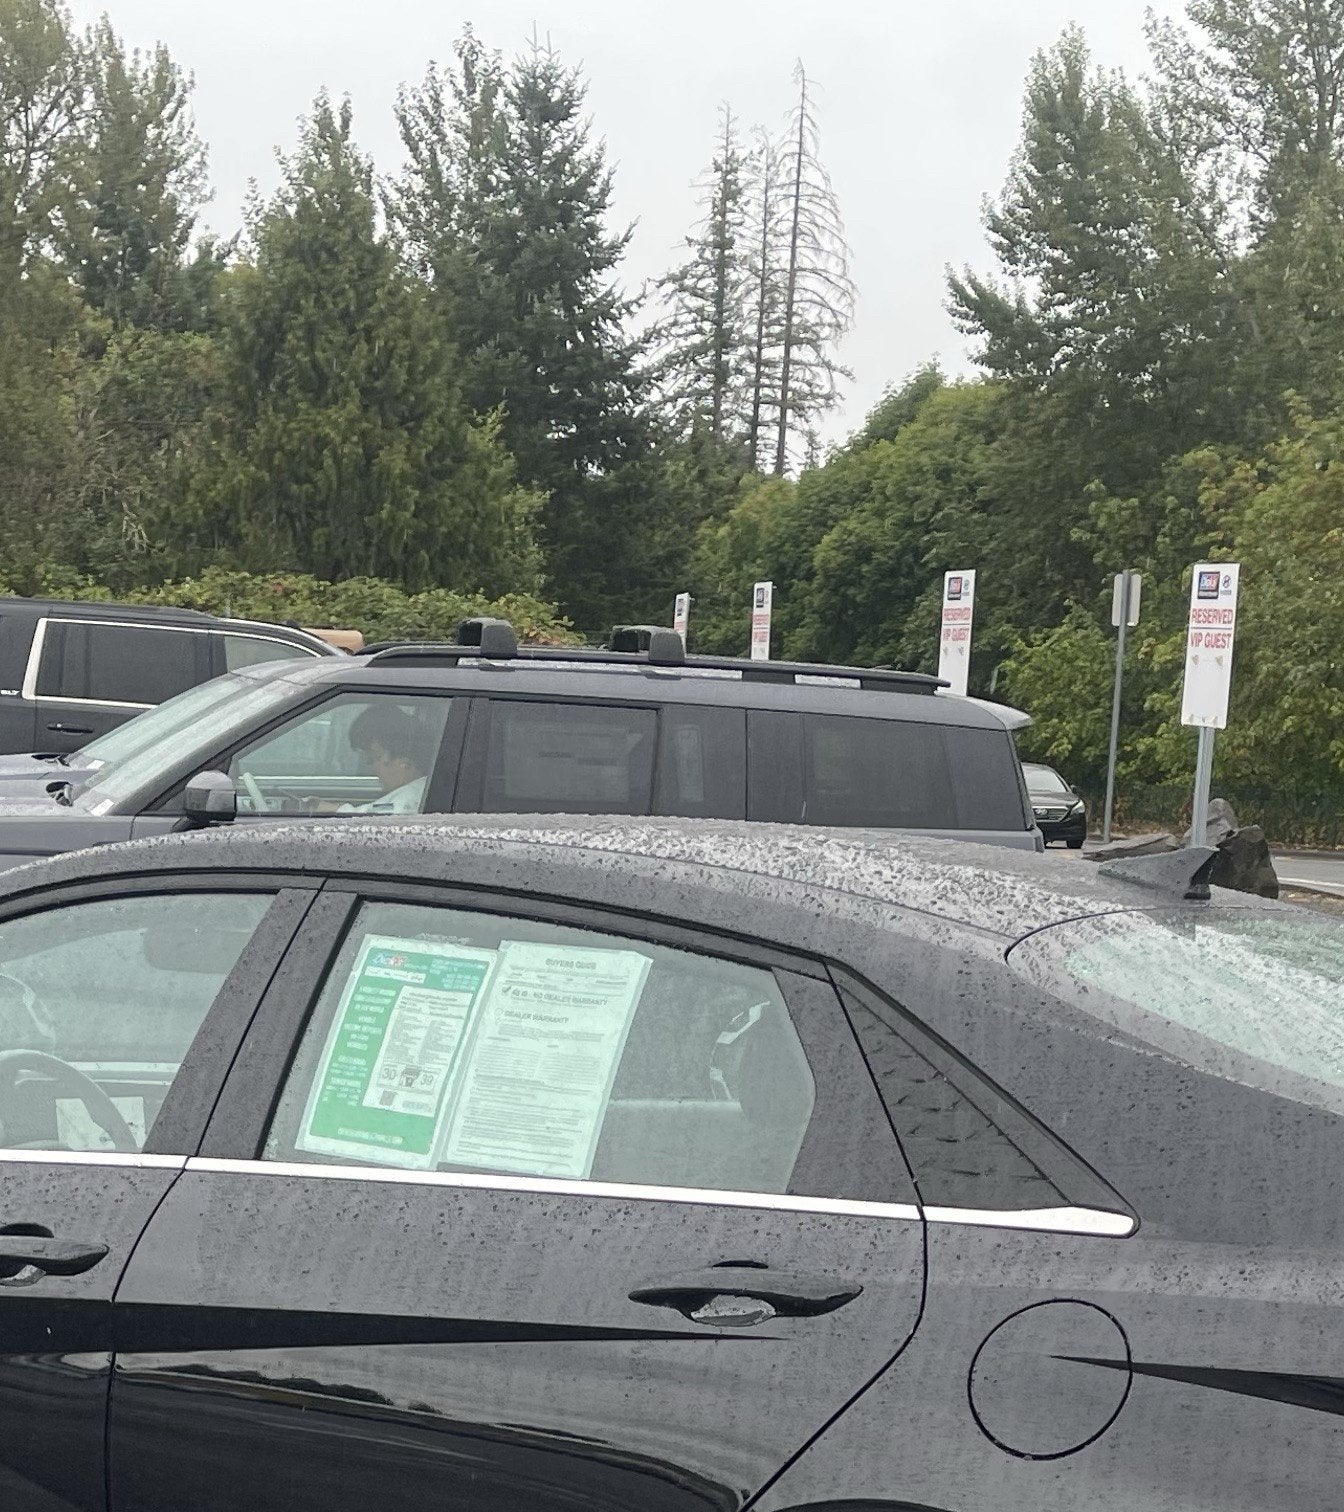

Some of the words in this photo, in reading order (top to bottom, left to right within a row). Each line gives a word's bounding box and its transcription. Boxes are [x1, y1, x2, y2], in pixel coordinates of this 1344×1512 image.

[1192, 608, 1233, 624] RESERVED
[1191, 632, 1203, 648] VIP
[1205, 632, 1231, 649] GUEST
